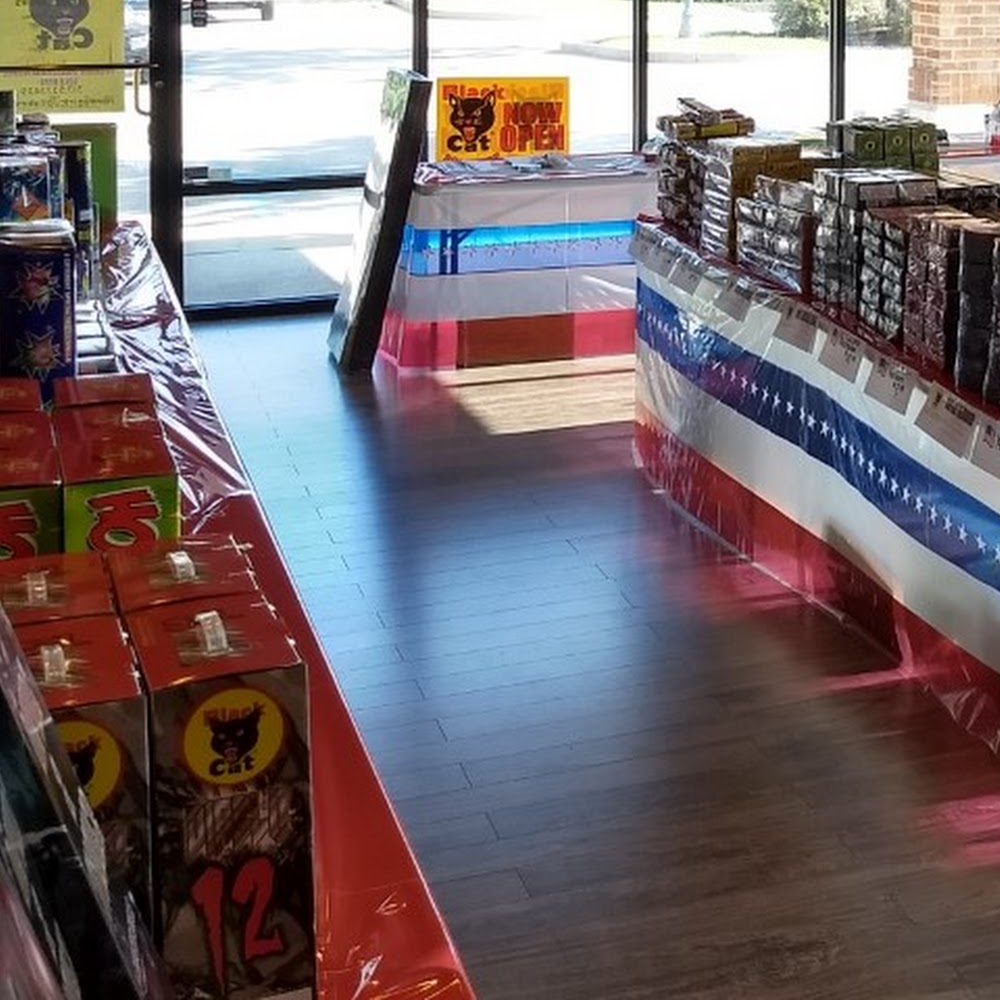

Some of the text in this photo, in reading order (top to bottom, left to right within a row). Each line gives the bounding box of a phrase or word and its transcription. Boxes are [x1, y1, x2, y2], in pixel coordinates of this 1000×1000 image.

[443, 84, 505, 101] Black
[503, 102, 563, 123] NOW
[447, 134, 491, 152] Cat
[501, 125, 565, 152] OPEN
[208, 756, 254, 777] Cat
[191, 857, 284, 986] 12
